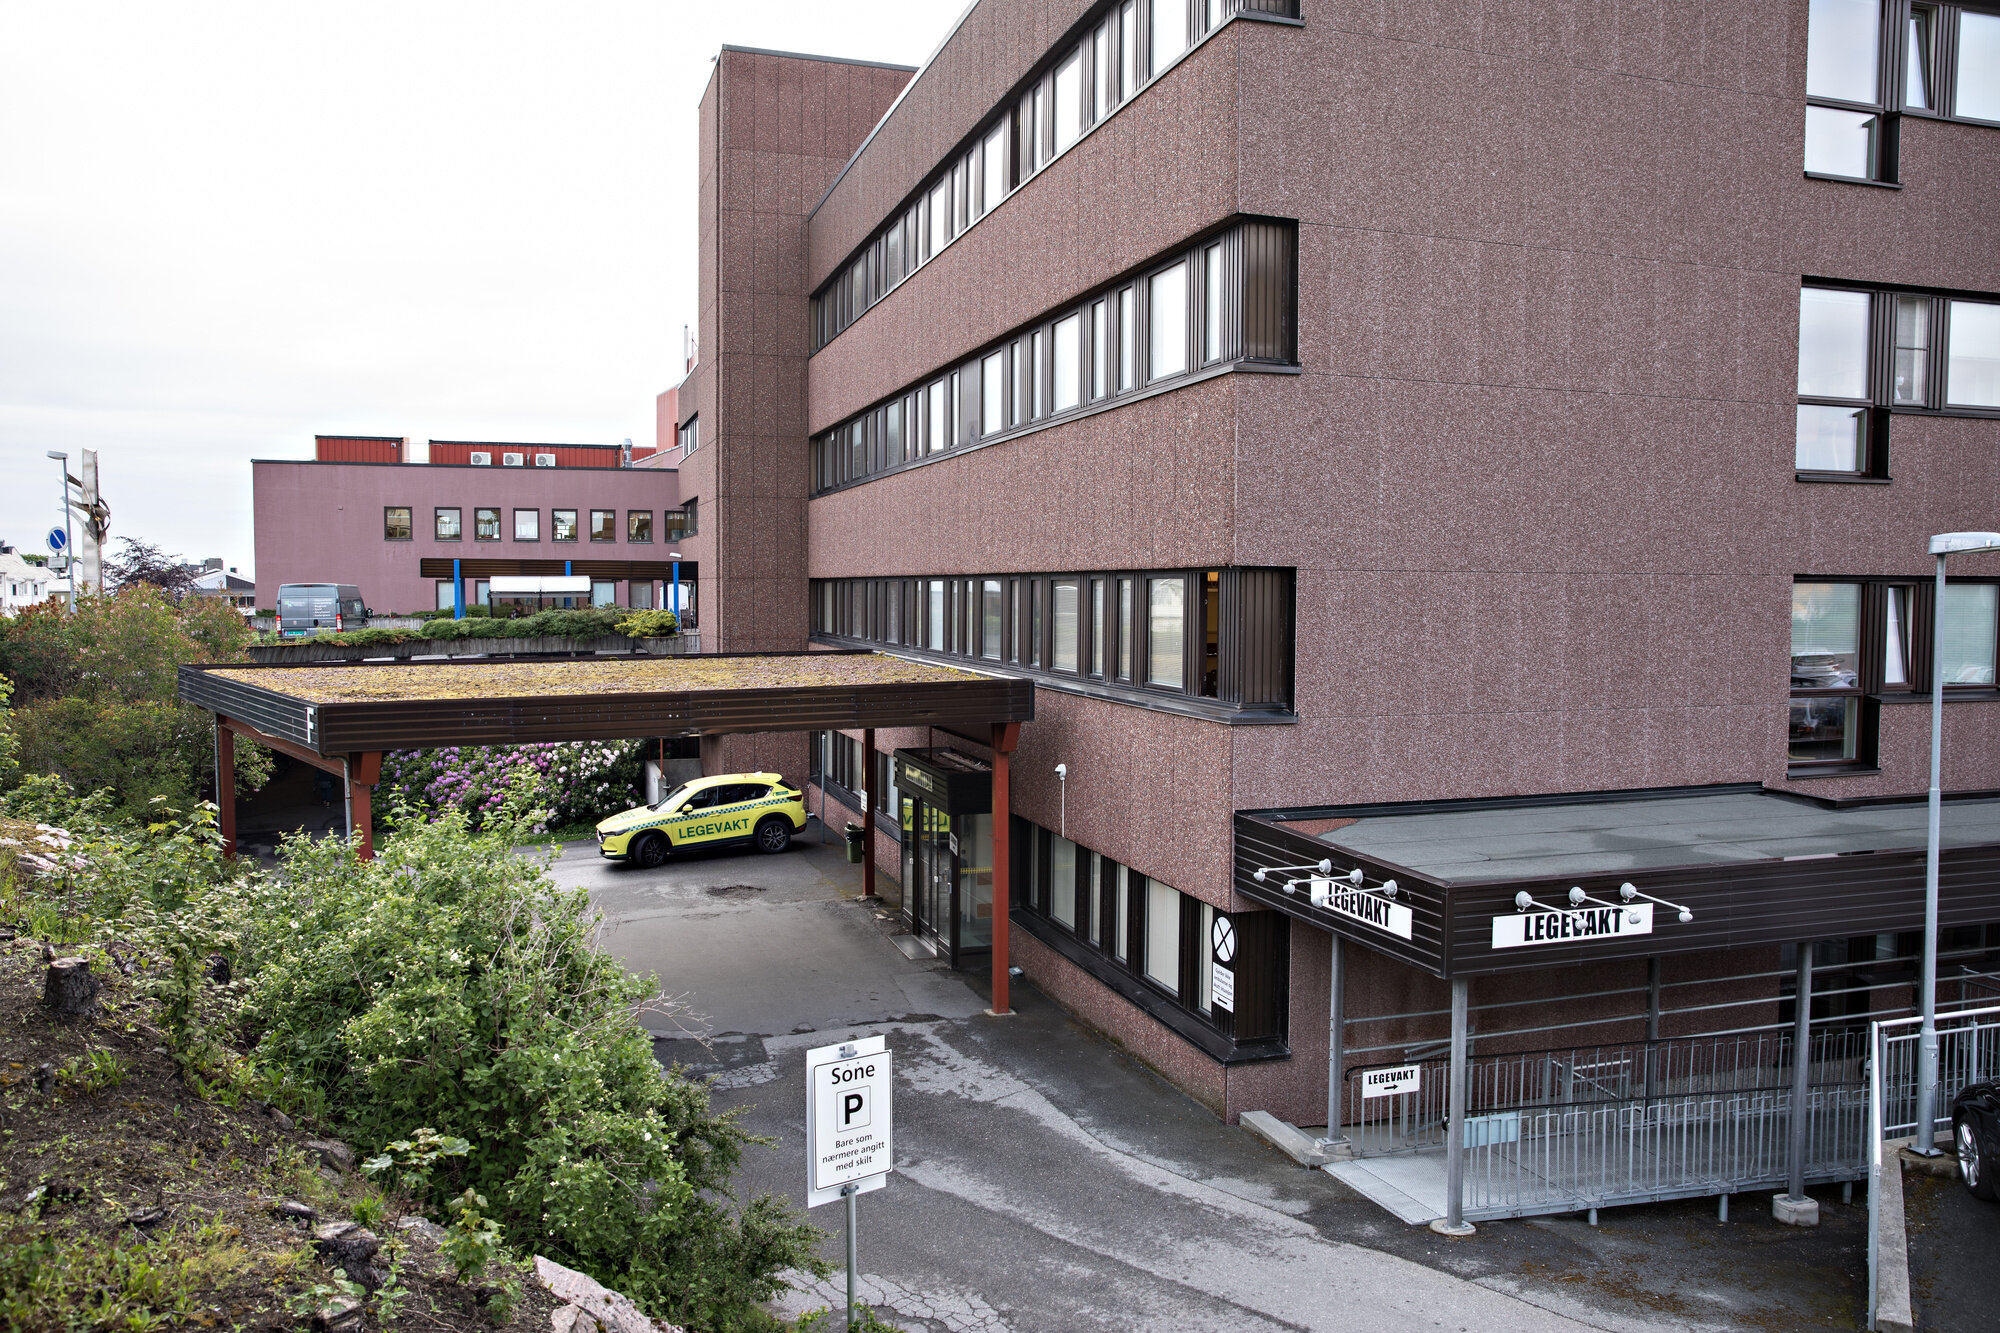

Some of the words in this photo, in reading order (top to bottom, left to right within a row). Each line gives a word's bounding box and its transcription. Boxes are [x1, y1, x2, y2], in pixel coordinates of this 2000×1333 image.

[678, 818, 749, 839] LEGEVAKT
[1328, 882, 1391, 928] LEGEVAKT
[831, 1064, 875, 1085] Sone
[1368, 1069, 1415, 1085] LEGEVAKT
[845, 1093, 863, 1125] P
[835, 1138, 854, 1149] Bare
[856, 1133, 873, 1144] som
[822, 1148, 859, 1163] nærmere
[861, 1141, 885, 1153] angitt
[835, 1159, 854, 1172] med
[856, 1155, 873, 1166] skilt
